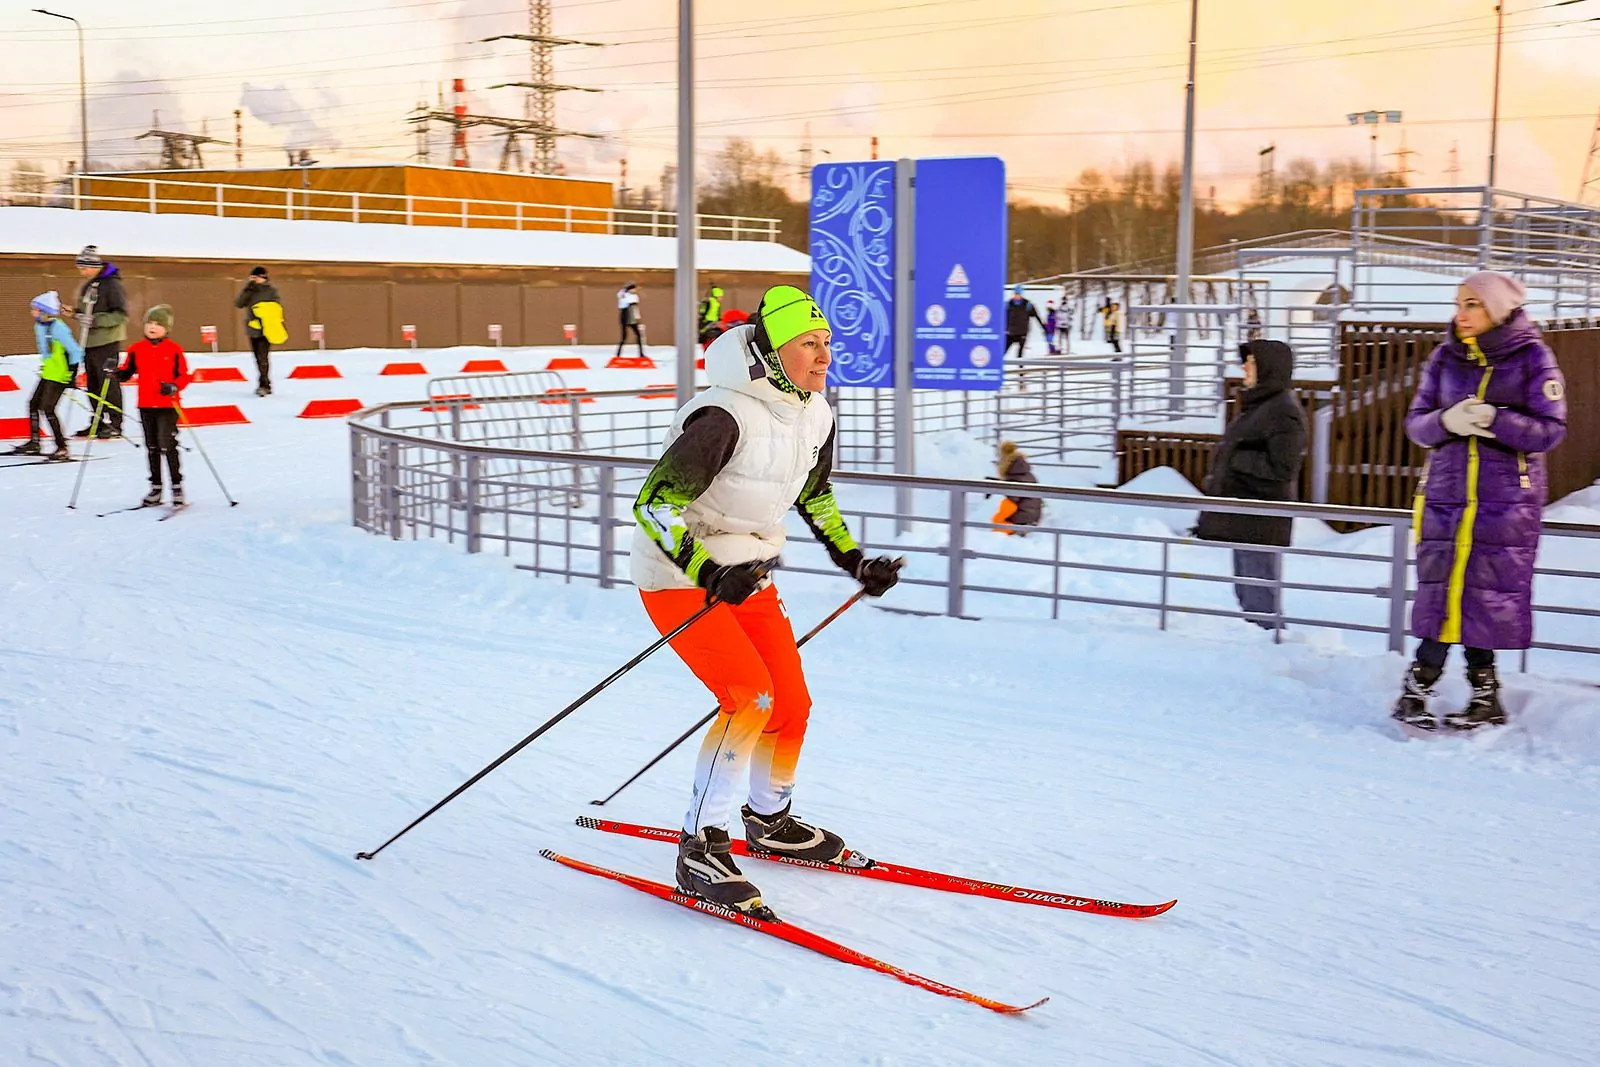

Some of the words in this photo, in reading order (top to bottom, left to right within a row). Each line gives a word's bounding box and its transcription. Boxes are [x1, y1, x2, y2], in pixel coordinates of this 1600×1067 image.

[638, 828, 681, 838] ATOMI
[778, 856, 831, 870] ATOMIC
[1013, 890, 1091, 907] ATOMIC
[694, 900, 737, 919] ATOMIC
